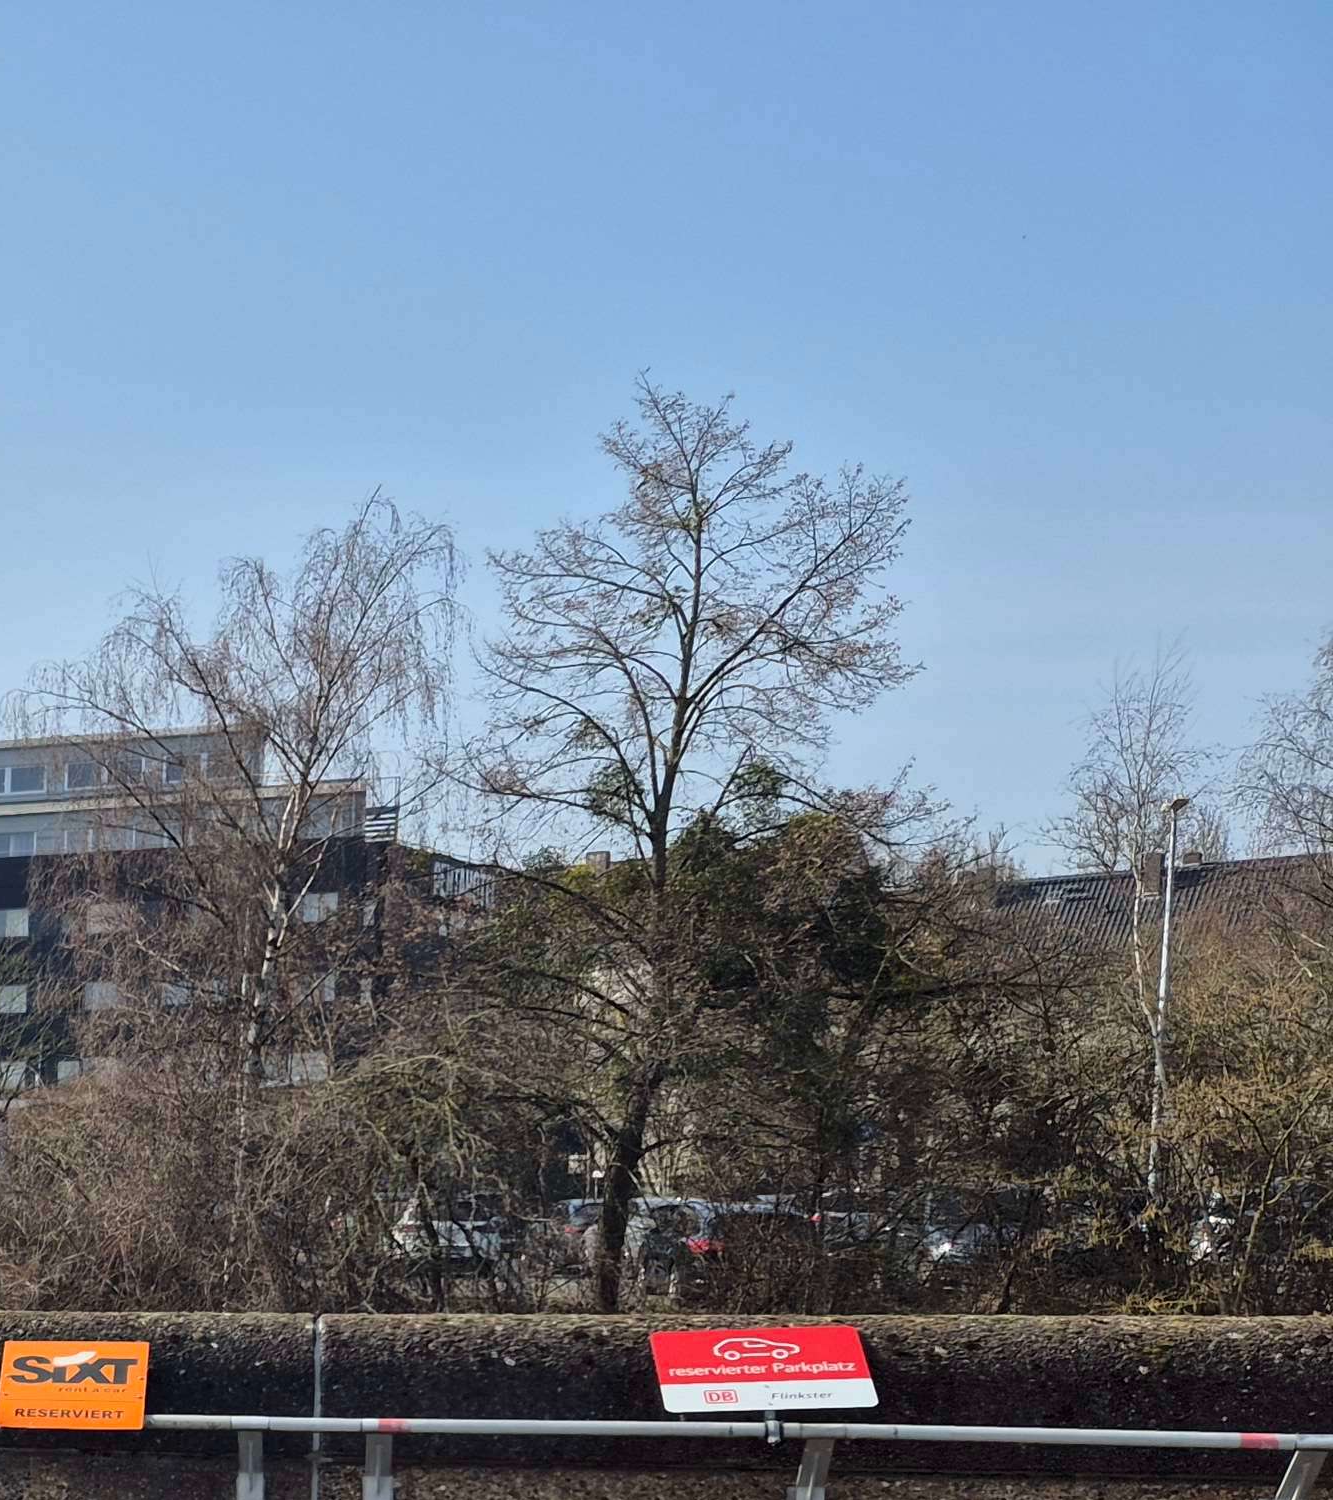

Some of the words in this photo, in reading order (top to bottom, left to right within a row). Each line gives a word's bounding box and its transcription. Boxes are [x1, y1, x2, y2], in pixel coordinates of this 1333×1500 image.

[668, 1363, 768, 1378] reservierter
[773, 1360, 857, 1375] Parkplatz
[706, 1391, 736, 1402] DB
[771, 1391, 833, 1401] Flinkster
[14, 1408, 125, 1420] RESERVIERT
